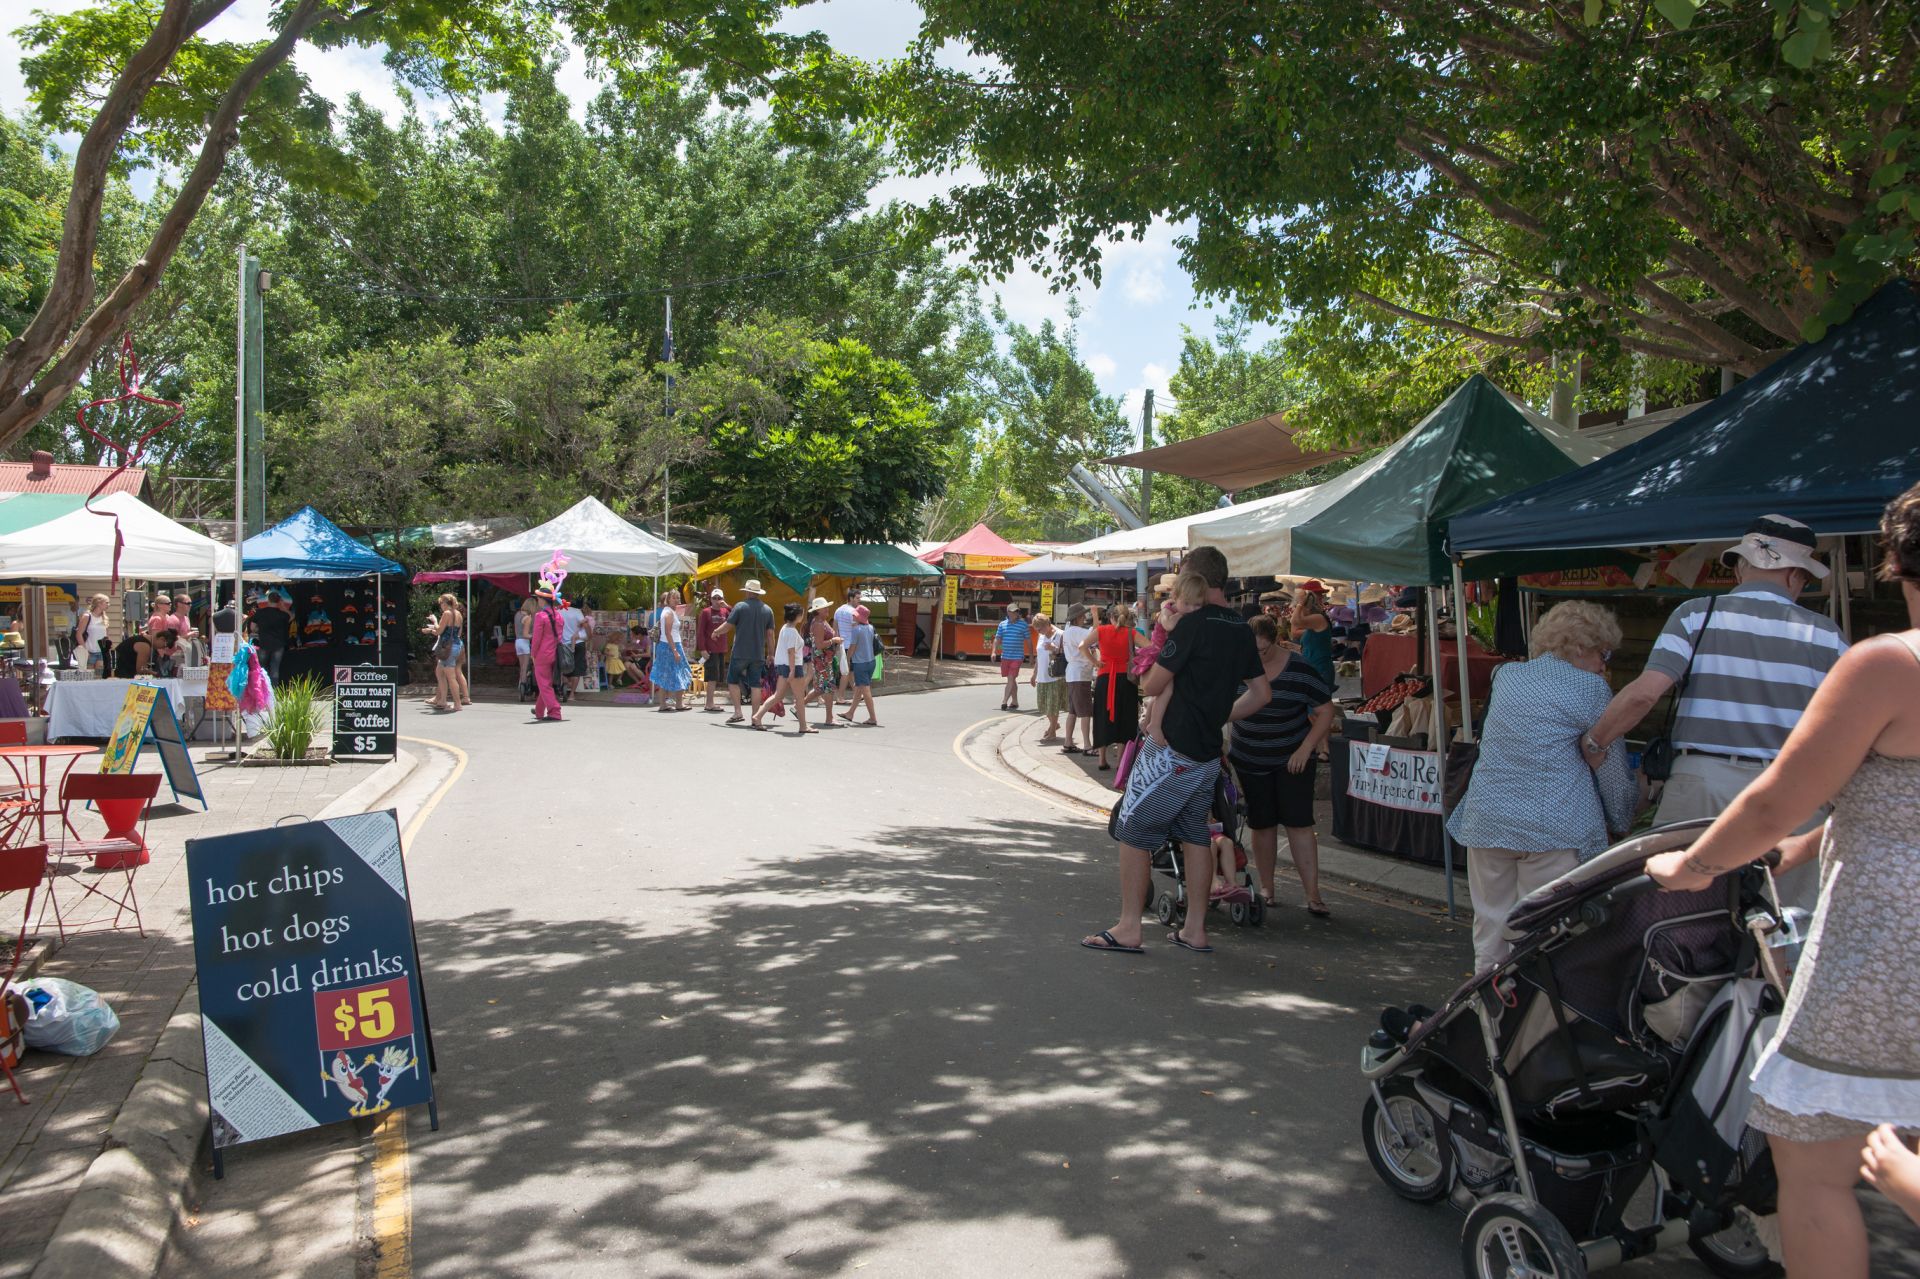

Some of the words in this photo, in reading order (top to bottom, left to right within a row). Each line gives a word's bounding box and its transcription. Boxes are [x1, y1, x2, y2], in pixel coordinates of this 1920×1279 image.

[354, 672, 388, 680] coffee
[342, 700, 353, 708] OR
[354, 700, 380, 708] COOKIE
[381, 700, 388, 708] &
[353, 714, 390, 728] coffee
[353, 735, 377, 752] $5
[206, 877, 259, 906] hot
[268, 863, 345, 897] chips
[220, 925, 273, 953] hot
[283, 912, 351, 944] dogs
[236, 964, 303, 1002] cold
[312, 949, 404, 988] drinks
[333, 988, 396, 1041] $5
